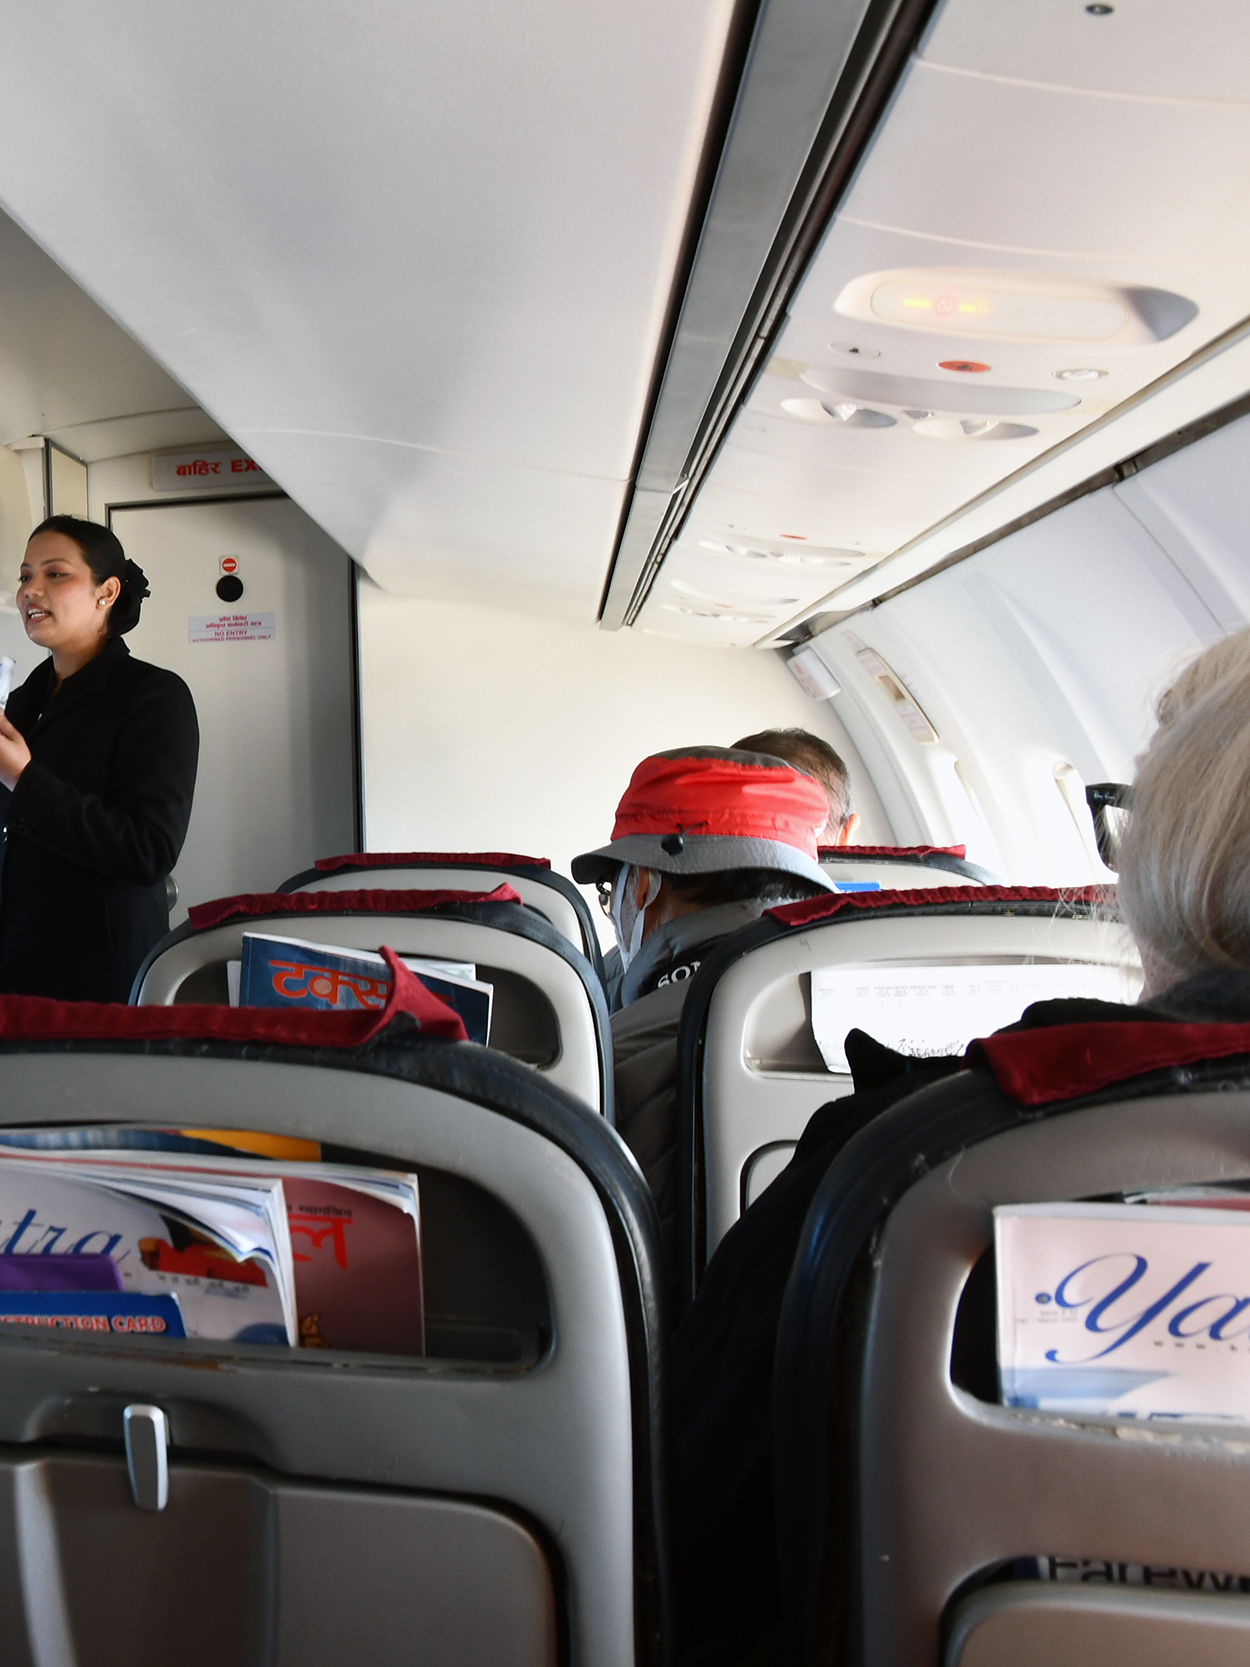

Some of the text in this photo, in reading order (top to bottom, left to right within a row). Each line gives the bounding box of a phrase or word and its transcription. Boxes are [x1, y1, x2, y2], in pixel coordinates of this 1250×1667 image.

[176, 458, 263, 476] बाहिर EX
[112, 1315, 167, 1333] CARD
